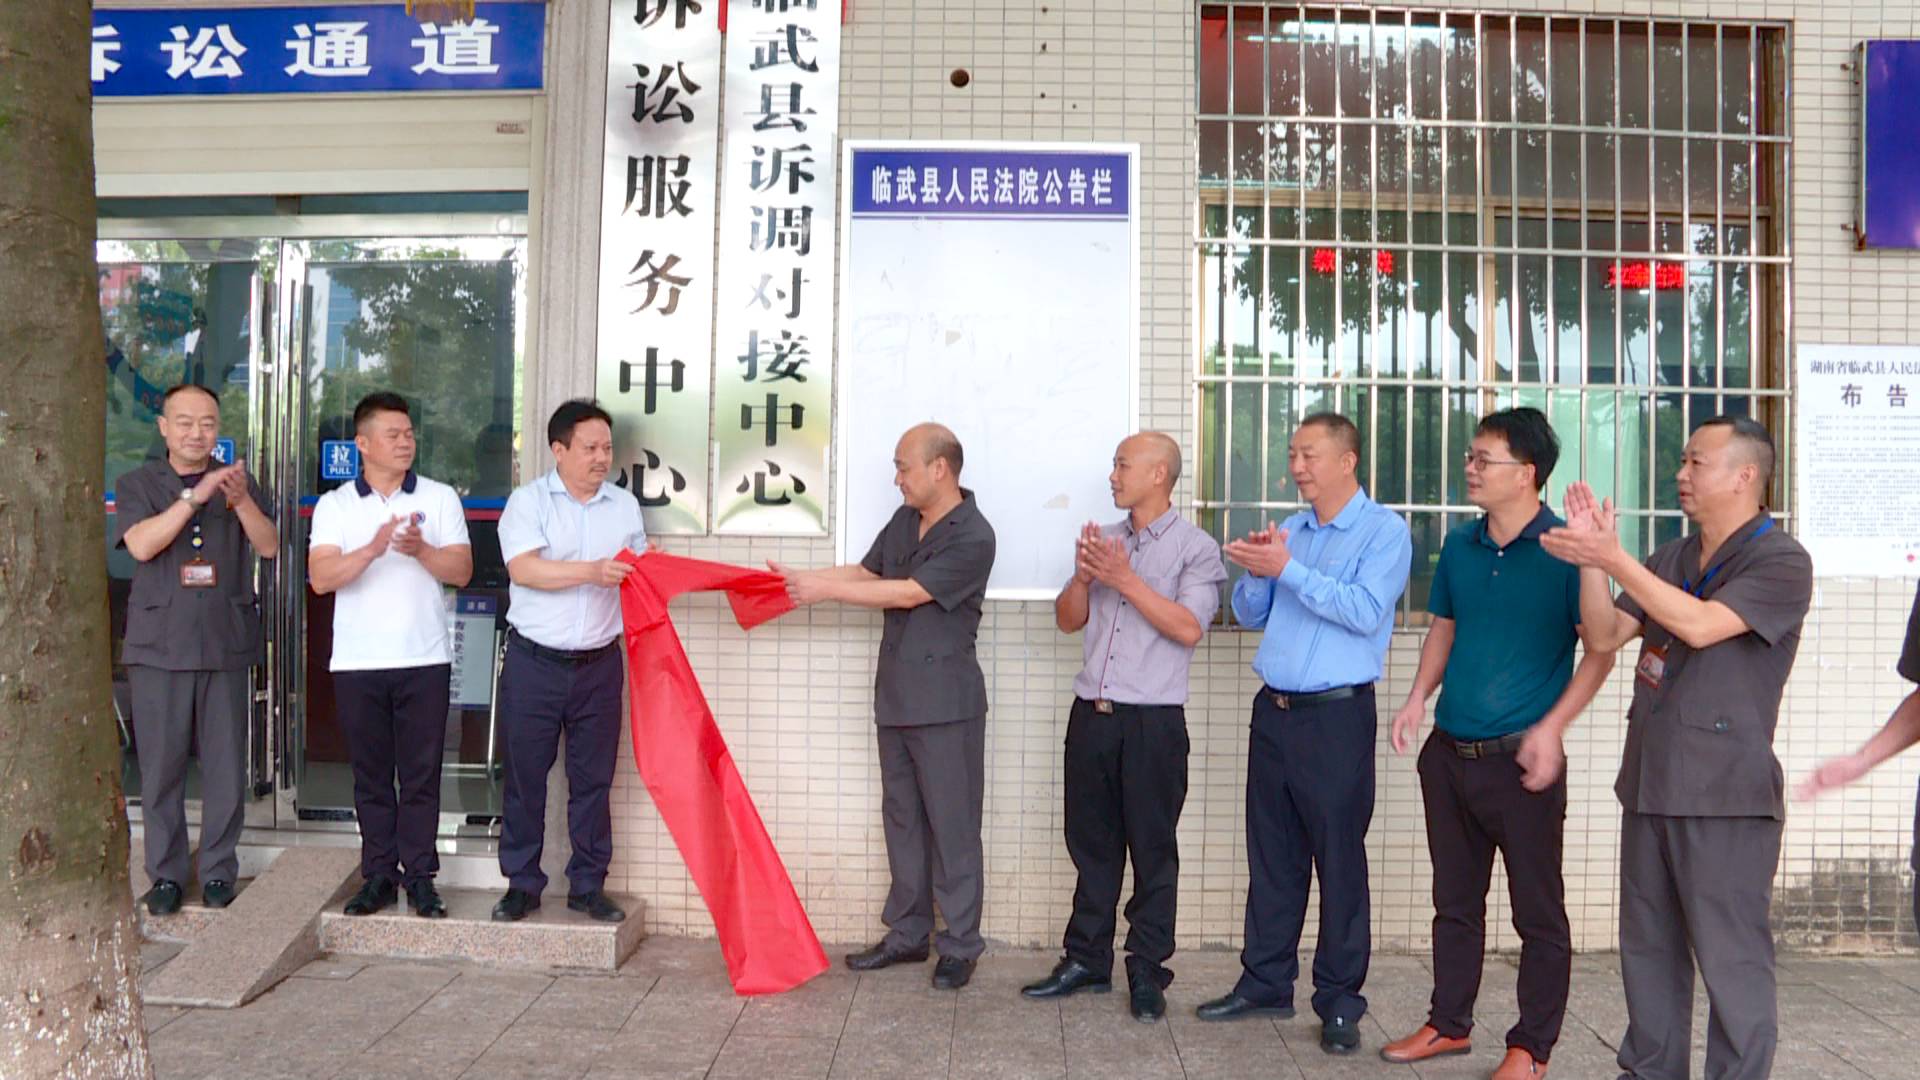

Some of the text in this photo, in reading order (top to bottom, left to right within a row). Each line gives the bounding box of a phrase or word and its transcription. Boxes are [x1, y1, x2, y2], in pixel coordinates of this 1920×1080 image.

[872, 165, 1113, 206] 临武县人民法院公告栏
[736, 0, 820, 506] 武县诉调对接中心
[1841, 383, 1908, 408] 布告
[331, 445, 351, 464] 拉
[329, 466, 352, 475] PULL
